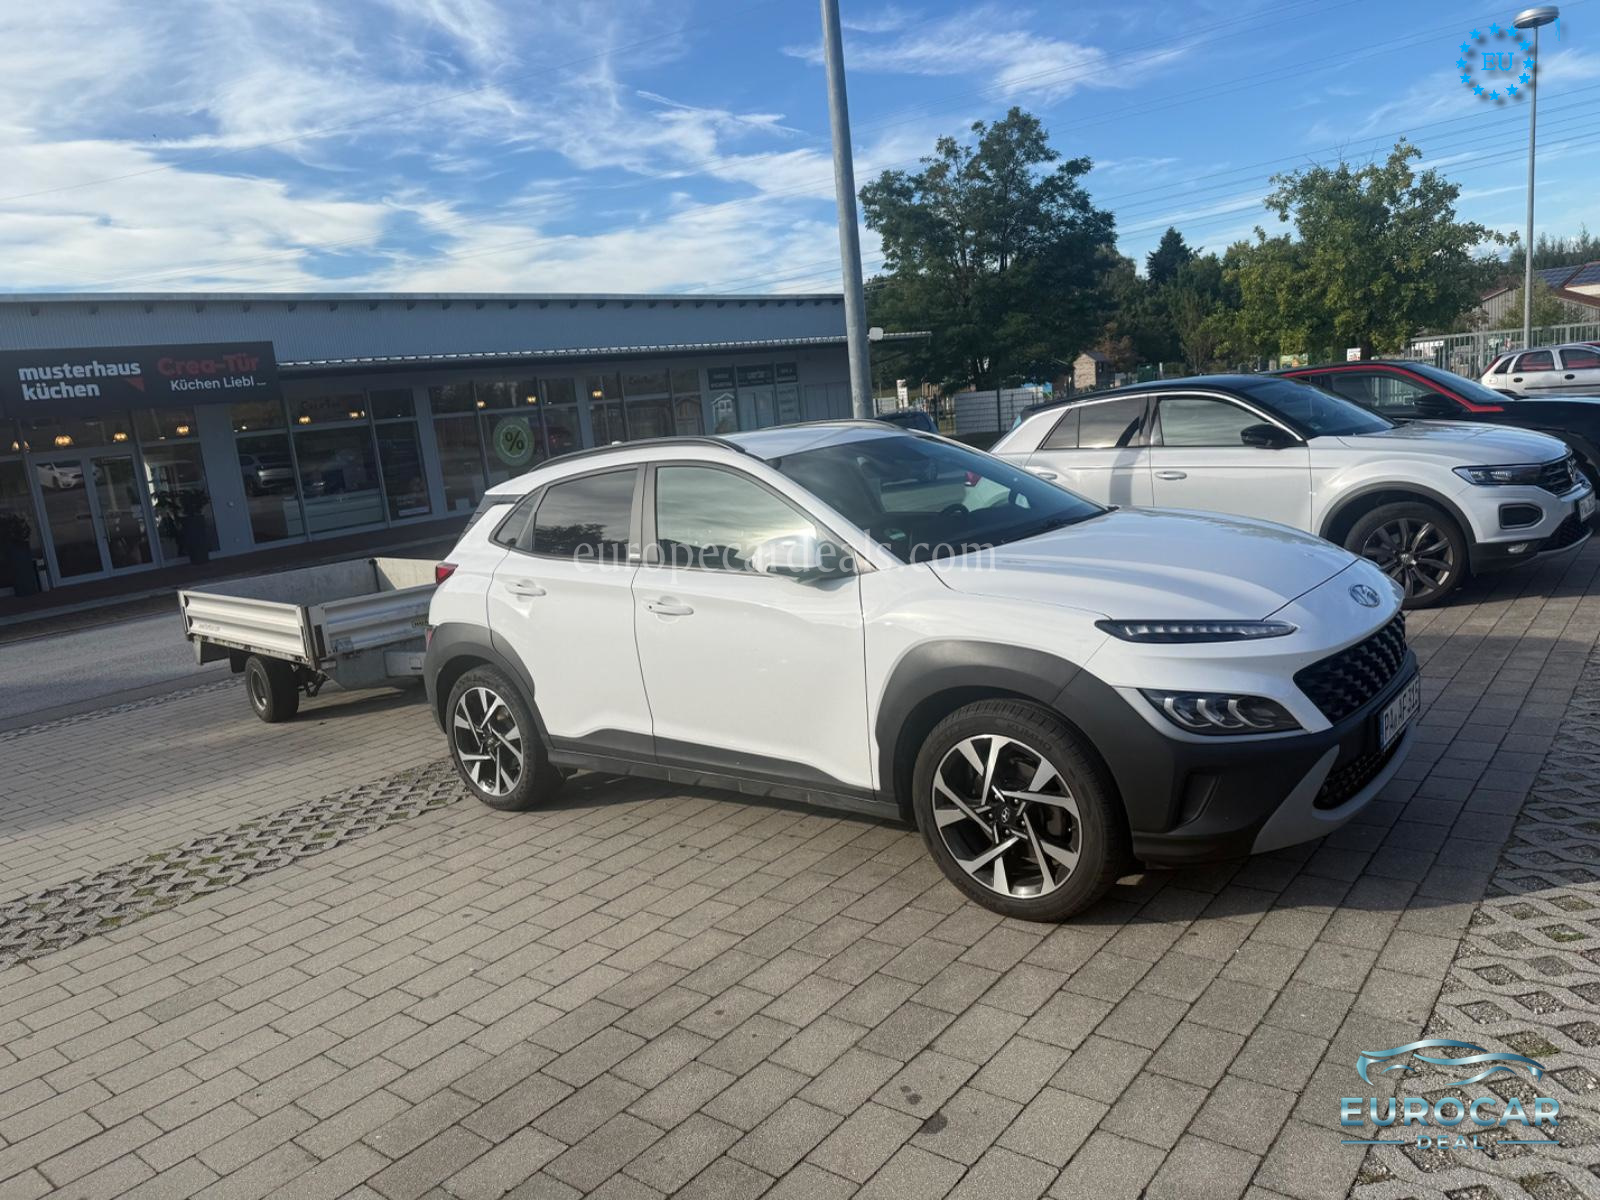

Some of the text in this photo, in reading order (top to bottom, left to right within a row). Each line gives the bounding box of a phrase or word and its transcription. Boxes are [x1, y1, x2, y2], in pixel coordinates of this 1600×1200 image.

[18, 360, 141, 381] musterhaus
[157, 354, 260, 377] Crea-Tür
[21, 381, 100, 401] küchen
[170, 375, 255, 392] Küchen Liebl
